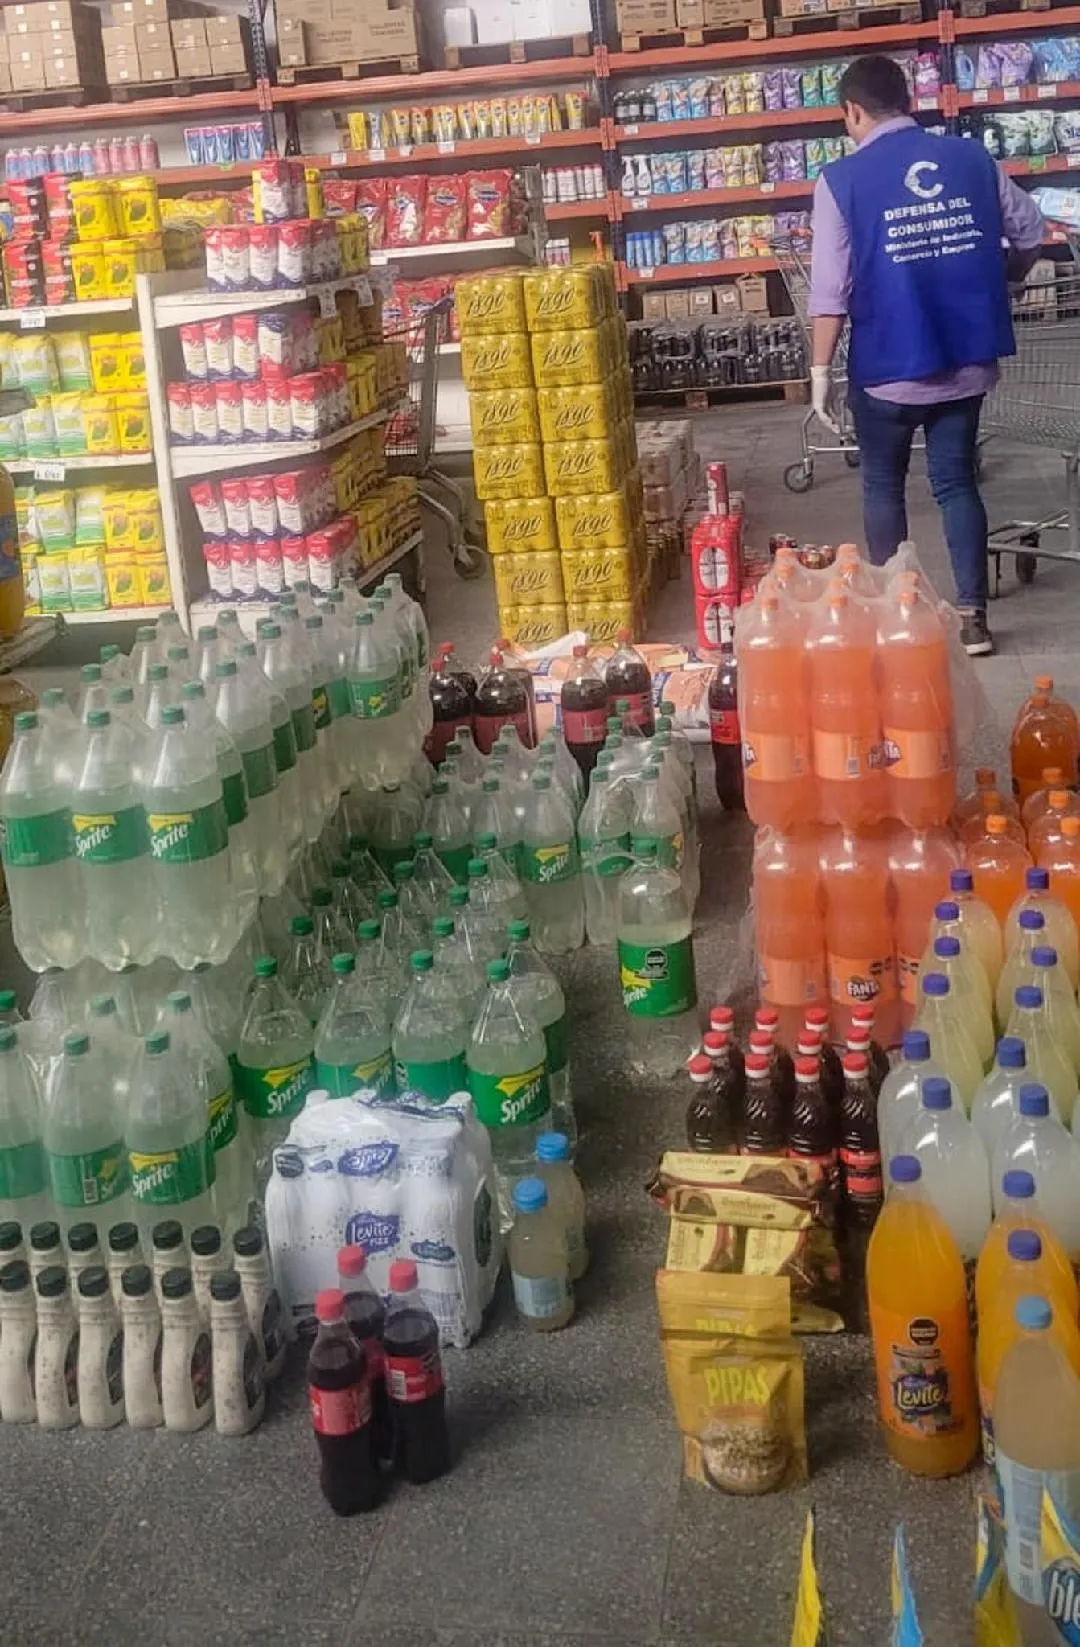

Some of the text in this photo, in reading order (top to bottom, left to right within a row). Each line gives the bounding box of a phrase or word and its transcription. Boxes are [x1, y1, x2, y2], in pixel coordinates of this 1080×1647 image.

[884, 197, 972, 221] DEFENSA DEL
[887, 213, 975, 238] CONSUMIDOR
[75, 825, 112, 858] Sprite
[150, 823, 189, 858] Sprite
[132, 1164, 173, 1199] Sprite
[704, 1367, 770, 1407] PIPAS
